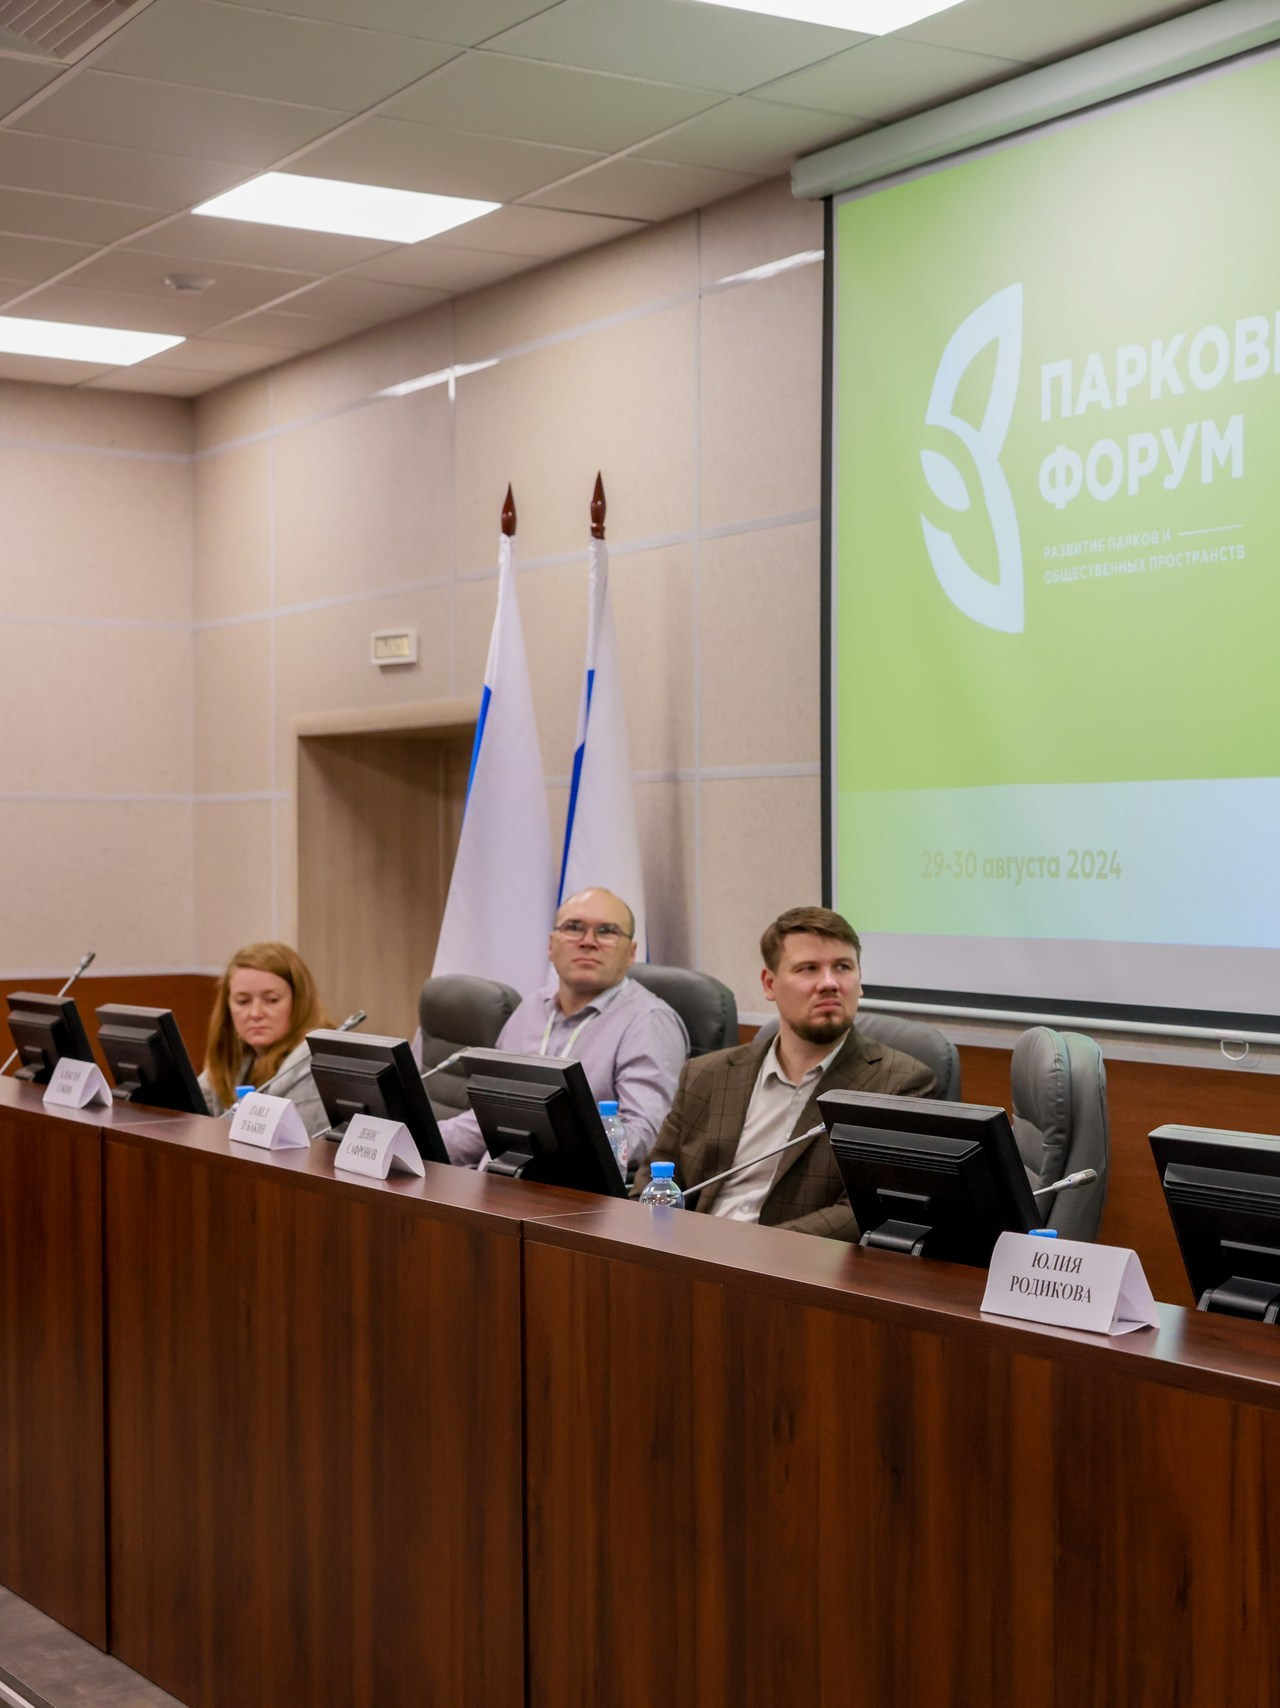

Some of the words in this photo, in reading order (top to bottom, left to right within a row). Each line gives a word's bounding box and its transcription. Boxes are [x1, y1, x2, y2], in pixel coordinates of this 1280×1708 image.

[1038, 413, 1244, 509] ФОРУМ
[1043, 537, 1105, 560] РАЗВИТИЕ
[1108, 530, 1160, 550] ПАРКОВ
[1162, 529, 1171, 543] И
[1044, 557, 1146, 584] ОБЩЕСТВЕННЫХ
[1149, 545, 1246, 570] ПРОСТРАНСТВ
[921, 850, 978, 879] 29-30
[982, 854, 1061, 886] августа
[1066, 849, 1122, 880] 2024
[1031, 1251, 1084, 1274] ЮЛИЯ
[1009, 1275, 1092, 1304] РОДИКОВА
